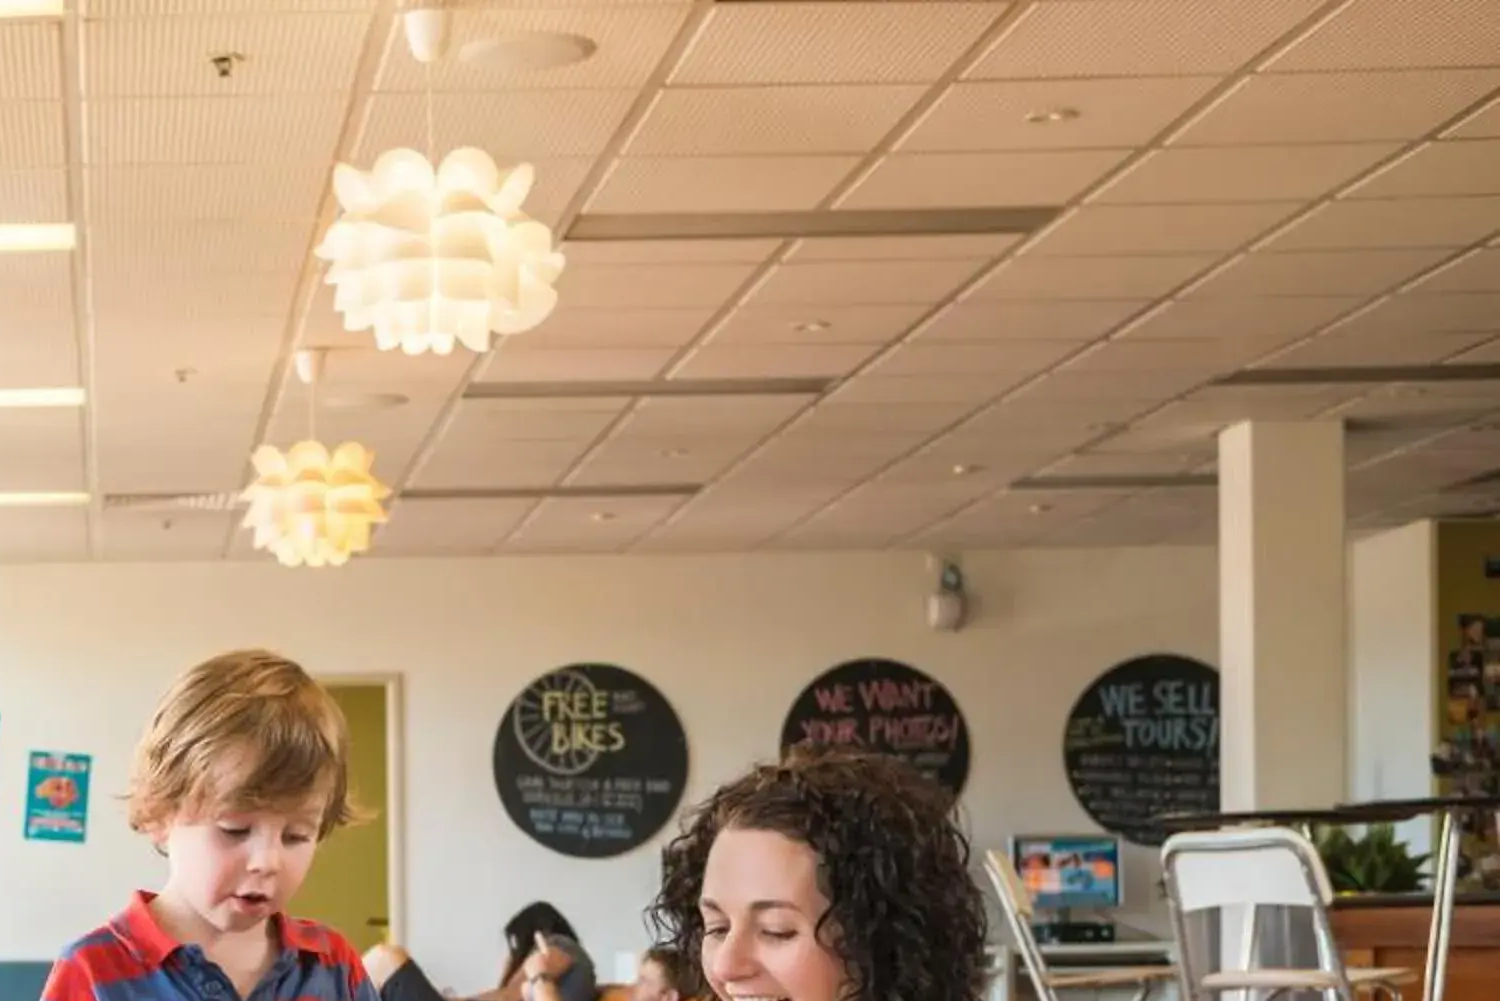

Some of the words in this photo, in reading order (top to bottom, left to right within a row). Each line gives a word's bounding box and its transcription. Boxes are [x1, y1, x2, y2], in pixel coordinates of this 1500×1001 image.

[542, 691, 608, 722] FREE
[814, 684, 854, 713] WE
[857, 680, 937, 710] WANT
[1100, 684, 1146, 716] WE
[1152, 681, 1215, 715] SELL
[552, 721, 626, 754] BIKES
[801, 718, 866, 746] YOUR
